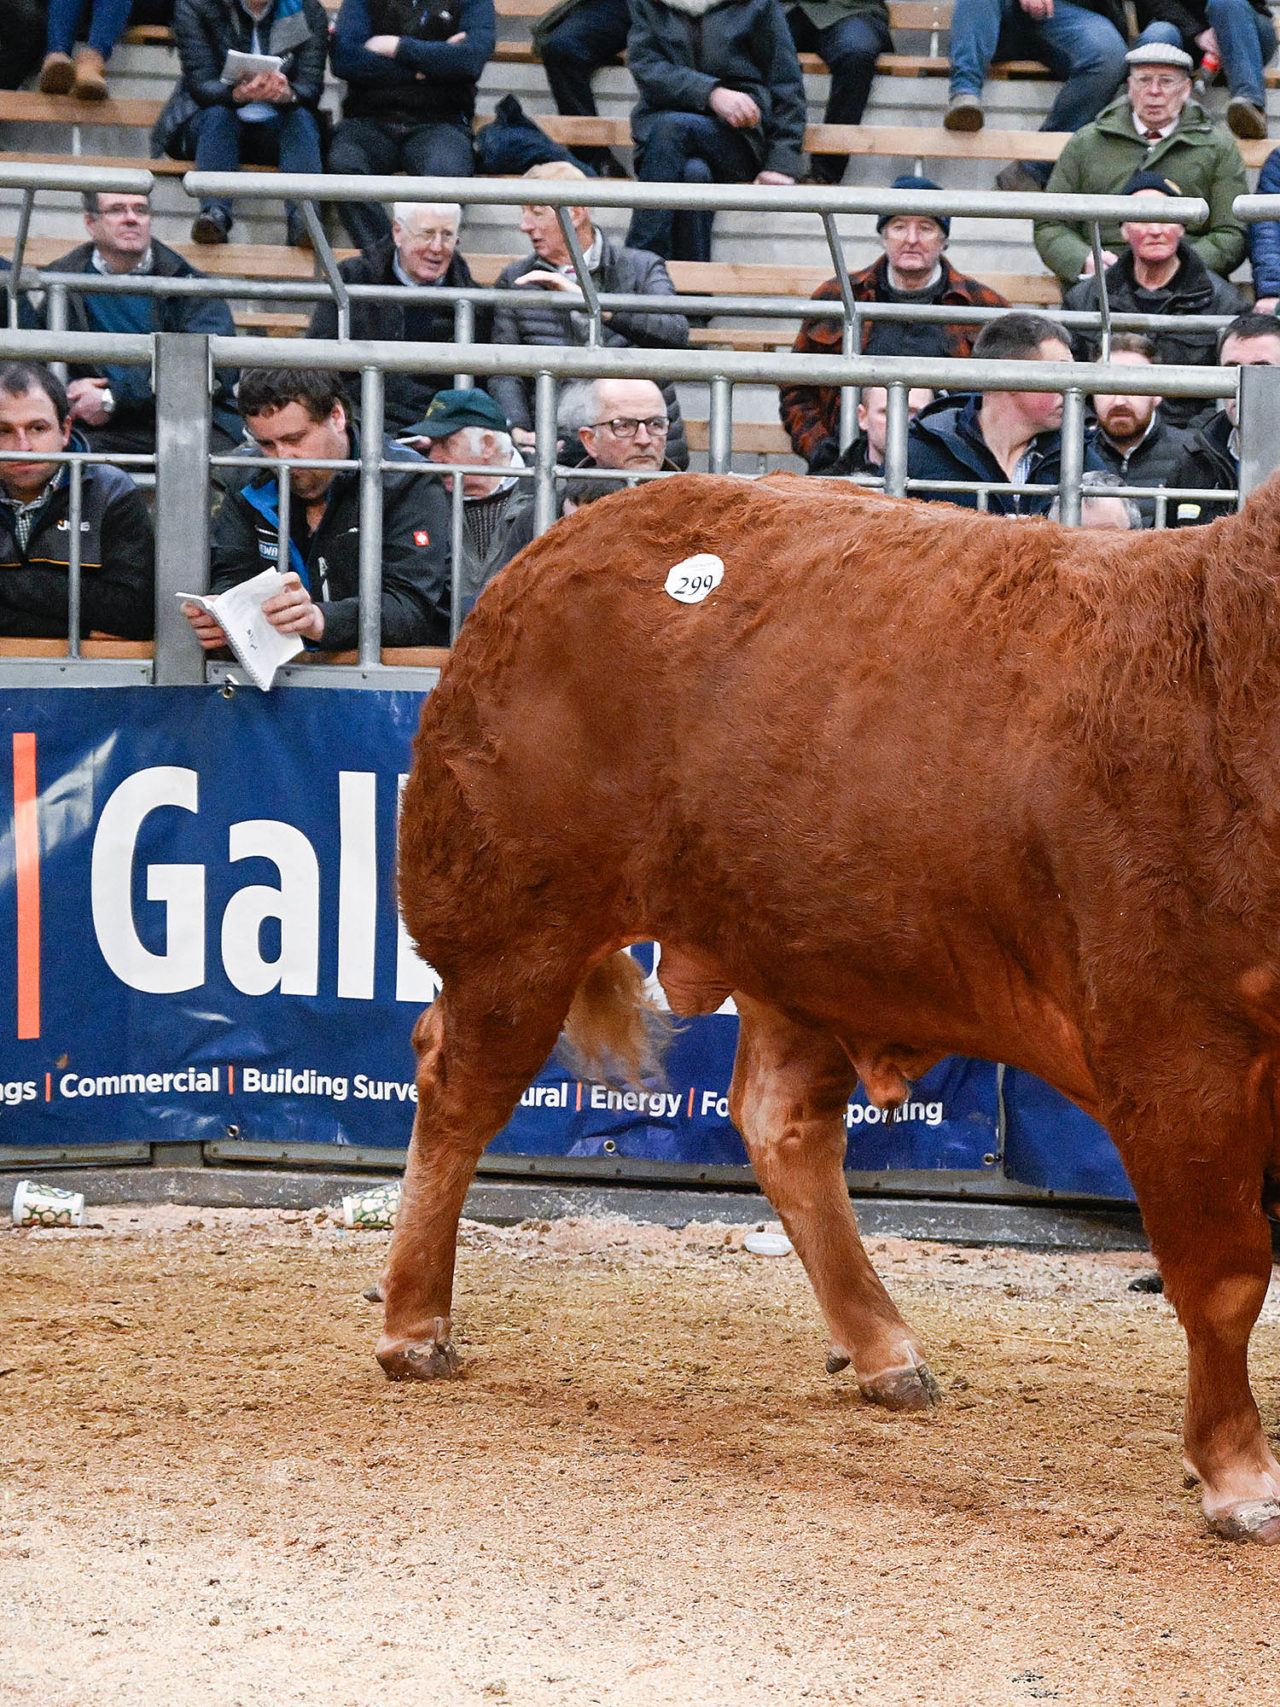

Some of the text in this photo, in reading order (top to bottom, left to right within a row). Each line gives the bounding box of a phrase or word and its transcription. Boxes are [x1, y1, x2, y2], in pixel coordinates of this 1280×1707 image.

[673, 574, 713, 595] 299
[59, 1067, 219, 1097] Commercial
[242, 1068, 348, 1101] Building
[590, 1085, 682, 1118] Energy
